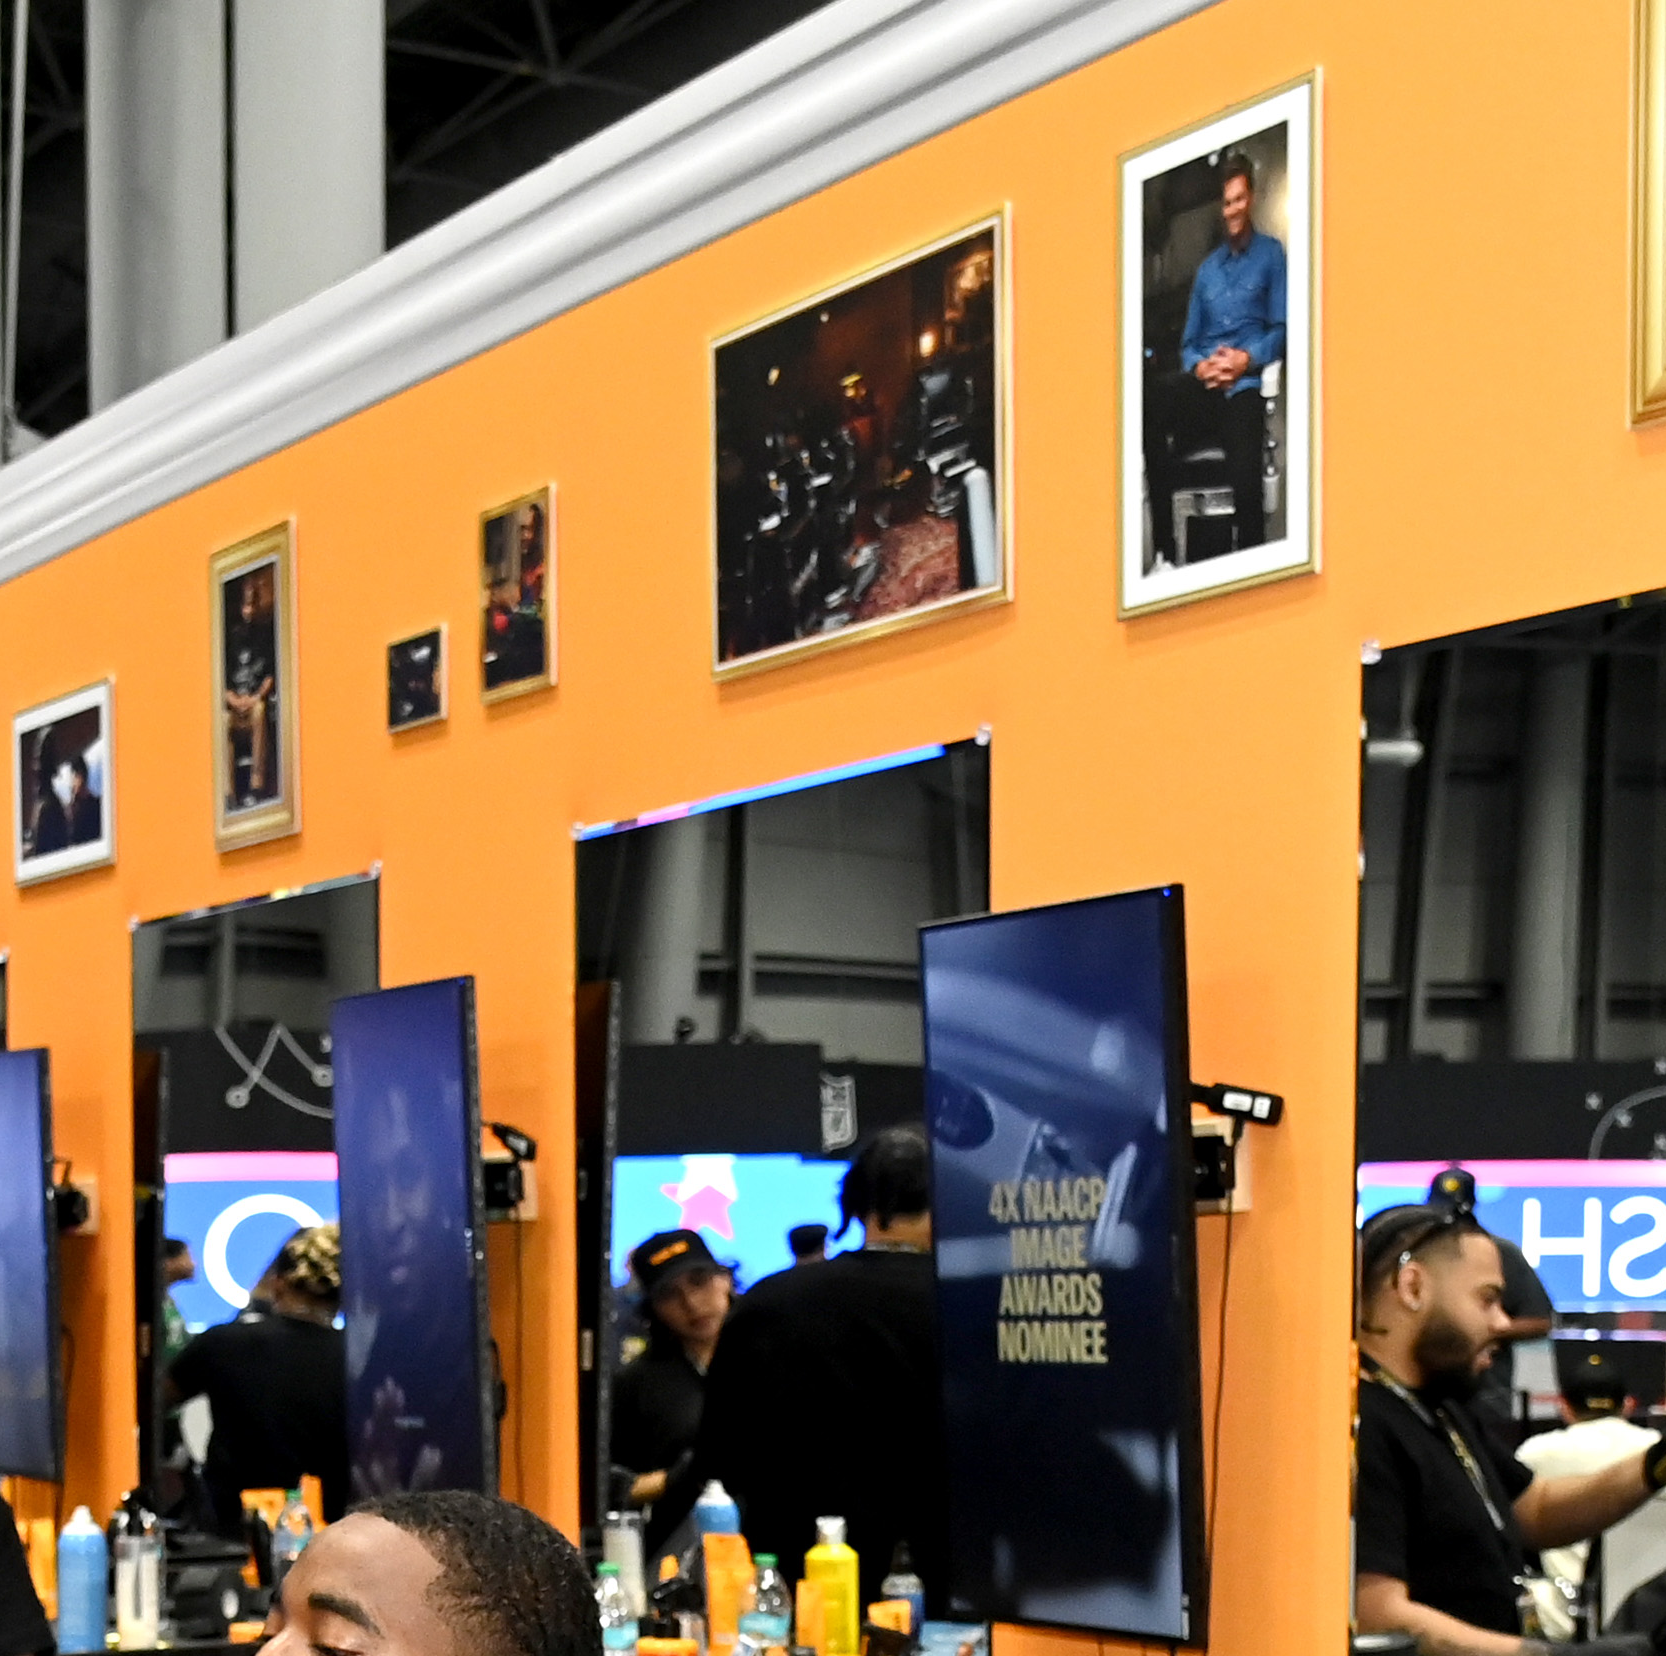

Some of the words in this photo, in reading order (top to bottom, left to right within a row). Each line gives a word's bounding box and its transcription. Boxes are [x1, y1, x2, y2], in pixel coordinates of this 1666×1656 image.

[989, 1181, 1021, 1223] 4X
[1023, 1177, 1107, 1222] NAACP
[1010, 1226, 1088, 1269] IMAGE
[999, 1273, 1103, 1316] AWARDS
[997, 1320, 1109, 1363] NOMINEE
